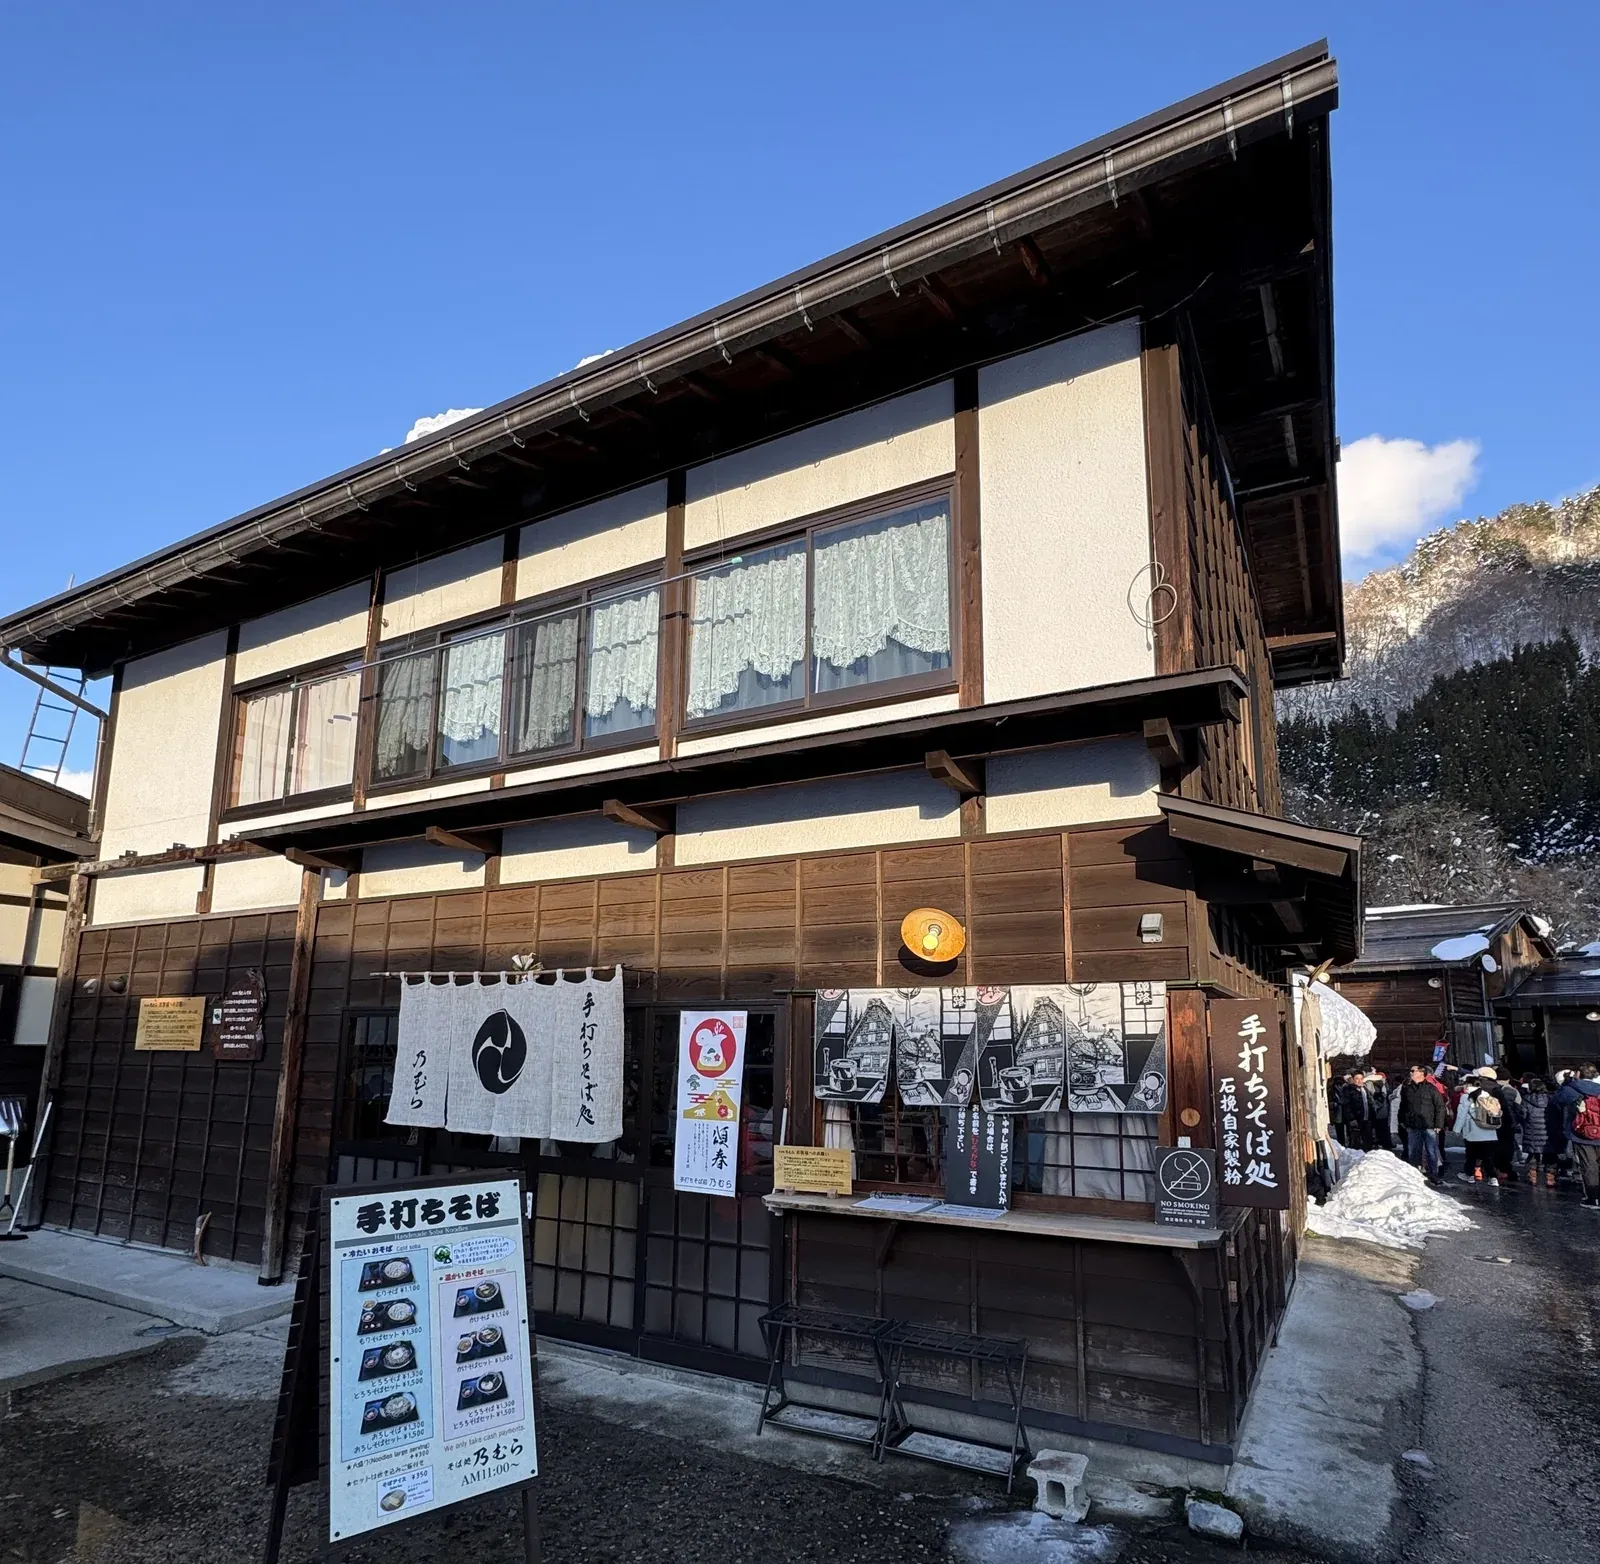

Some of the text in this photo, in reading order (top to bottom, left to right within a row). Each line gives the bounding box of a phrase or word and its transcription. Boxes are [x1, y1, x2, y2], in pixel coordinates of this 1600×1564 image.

[576, 991, 598, 1127] 手打ちそば処
[410, 1050, 427, 1110] 乃むら
[1237, 1013, 1278, 1189] 手打ちそば処
[1219, 1077, 1243, 1186] 石挽自家製粉
[711, 1125, 729, 1170] 頌春
[356, 1191, 501, 1234] 手打ちそば
[1173, 1201, 1210, 1210] SMOKING
[394, 1225, 469, 1241] Handmade Soba Noodles
[376, 1287, 399, 1298] もりそば
[359, 1331, 399, 1345] もりそばセット
[371, 1374, 401, 1387] とろろそば
[353, 1383, 401, 1400] とろろそばセット
[371, 1420, 425, 1441] おろしそば ¥1,300
[353, 1428, 425, 1454] おろしそばセット ¥1,500
[455, 1441, 468, 1450] only
[469, 1437, 482, 1446] take
[483, 1432, 498, 1441] cash
[394, 1449, 408, 1458] large
[411, 1470, 428, 1481] ¥350
